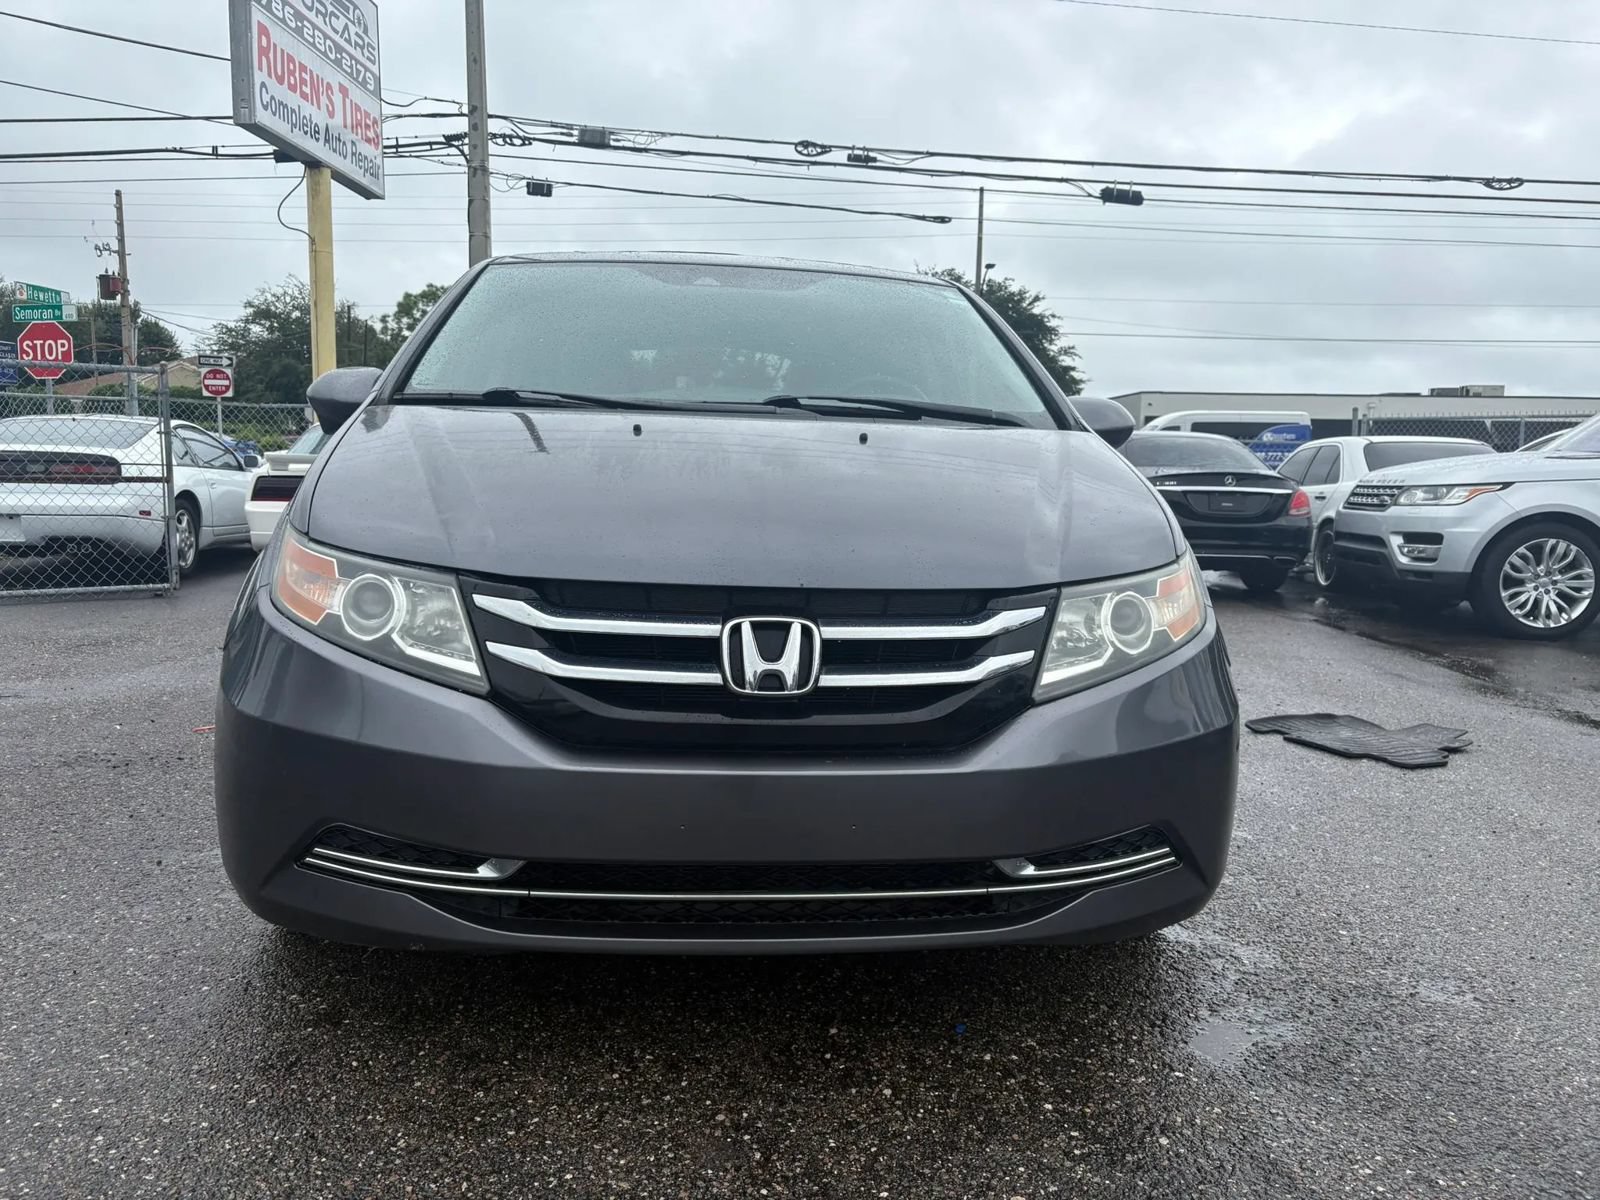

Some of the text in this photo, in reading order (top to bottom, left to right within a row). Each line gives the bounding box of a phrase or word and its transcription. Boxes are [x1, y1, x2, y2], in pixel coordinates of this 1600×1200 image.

[260, 0, 375, 91] 86-280-2179
[257, 20, 380, 151] RUBEN'S TIRES
[259, 81, 380, 181] Complete Auto Repair
[15, 307, 53, 320] Semoran
[27, 286, 57, 304] Hewett
[22, 340, 69, 360] STOP
